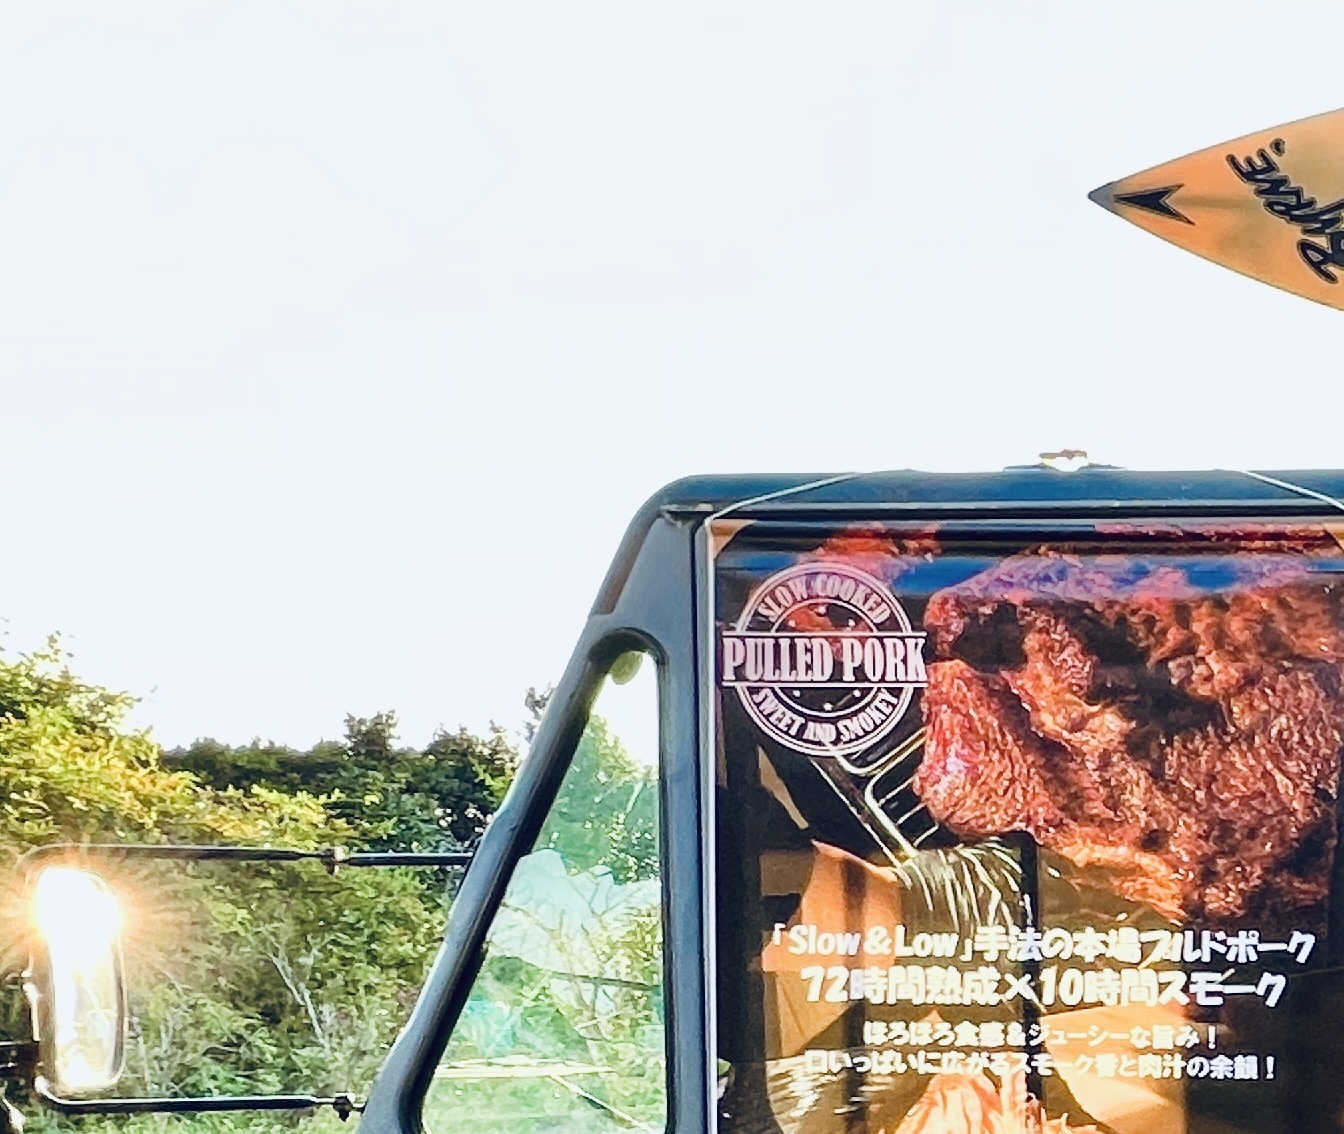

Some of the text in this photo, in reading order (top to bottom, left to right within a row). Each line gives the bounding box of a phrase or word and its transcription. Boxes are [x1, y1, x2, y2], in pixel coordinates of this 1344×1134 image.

[757, 574, 892, 625] SLOW COOKED
[723, 637, 928, 682] PULLED PORK
[753, 688, 898, 743] SWEET AND SMOKEY
